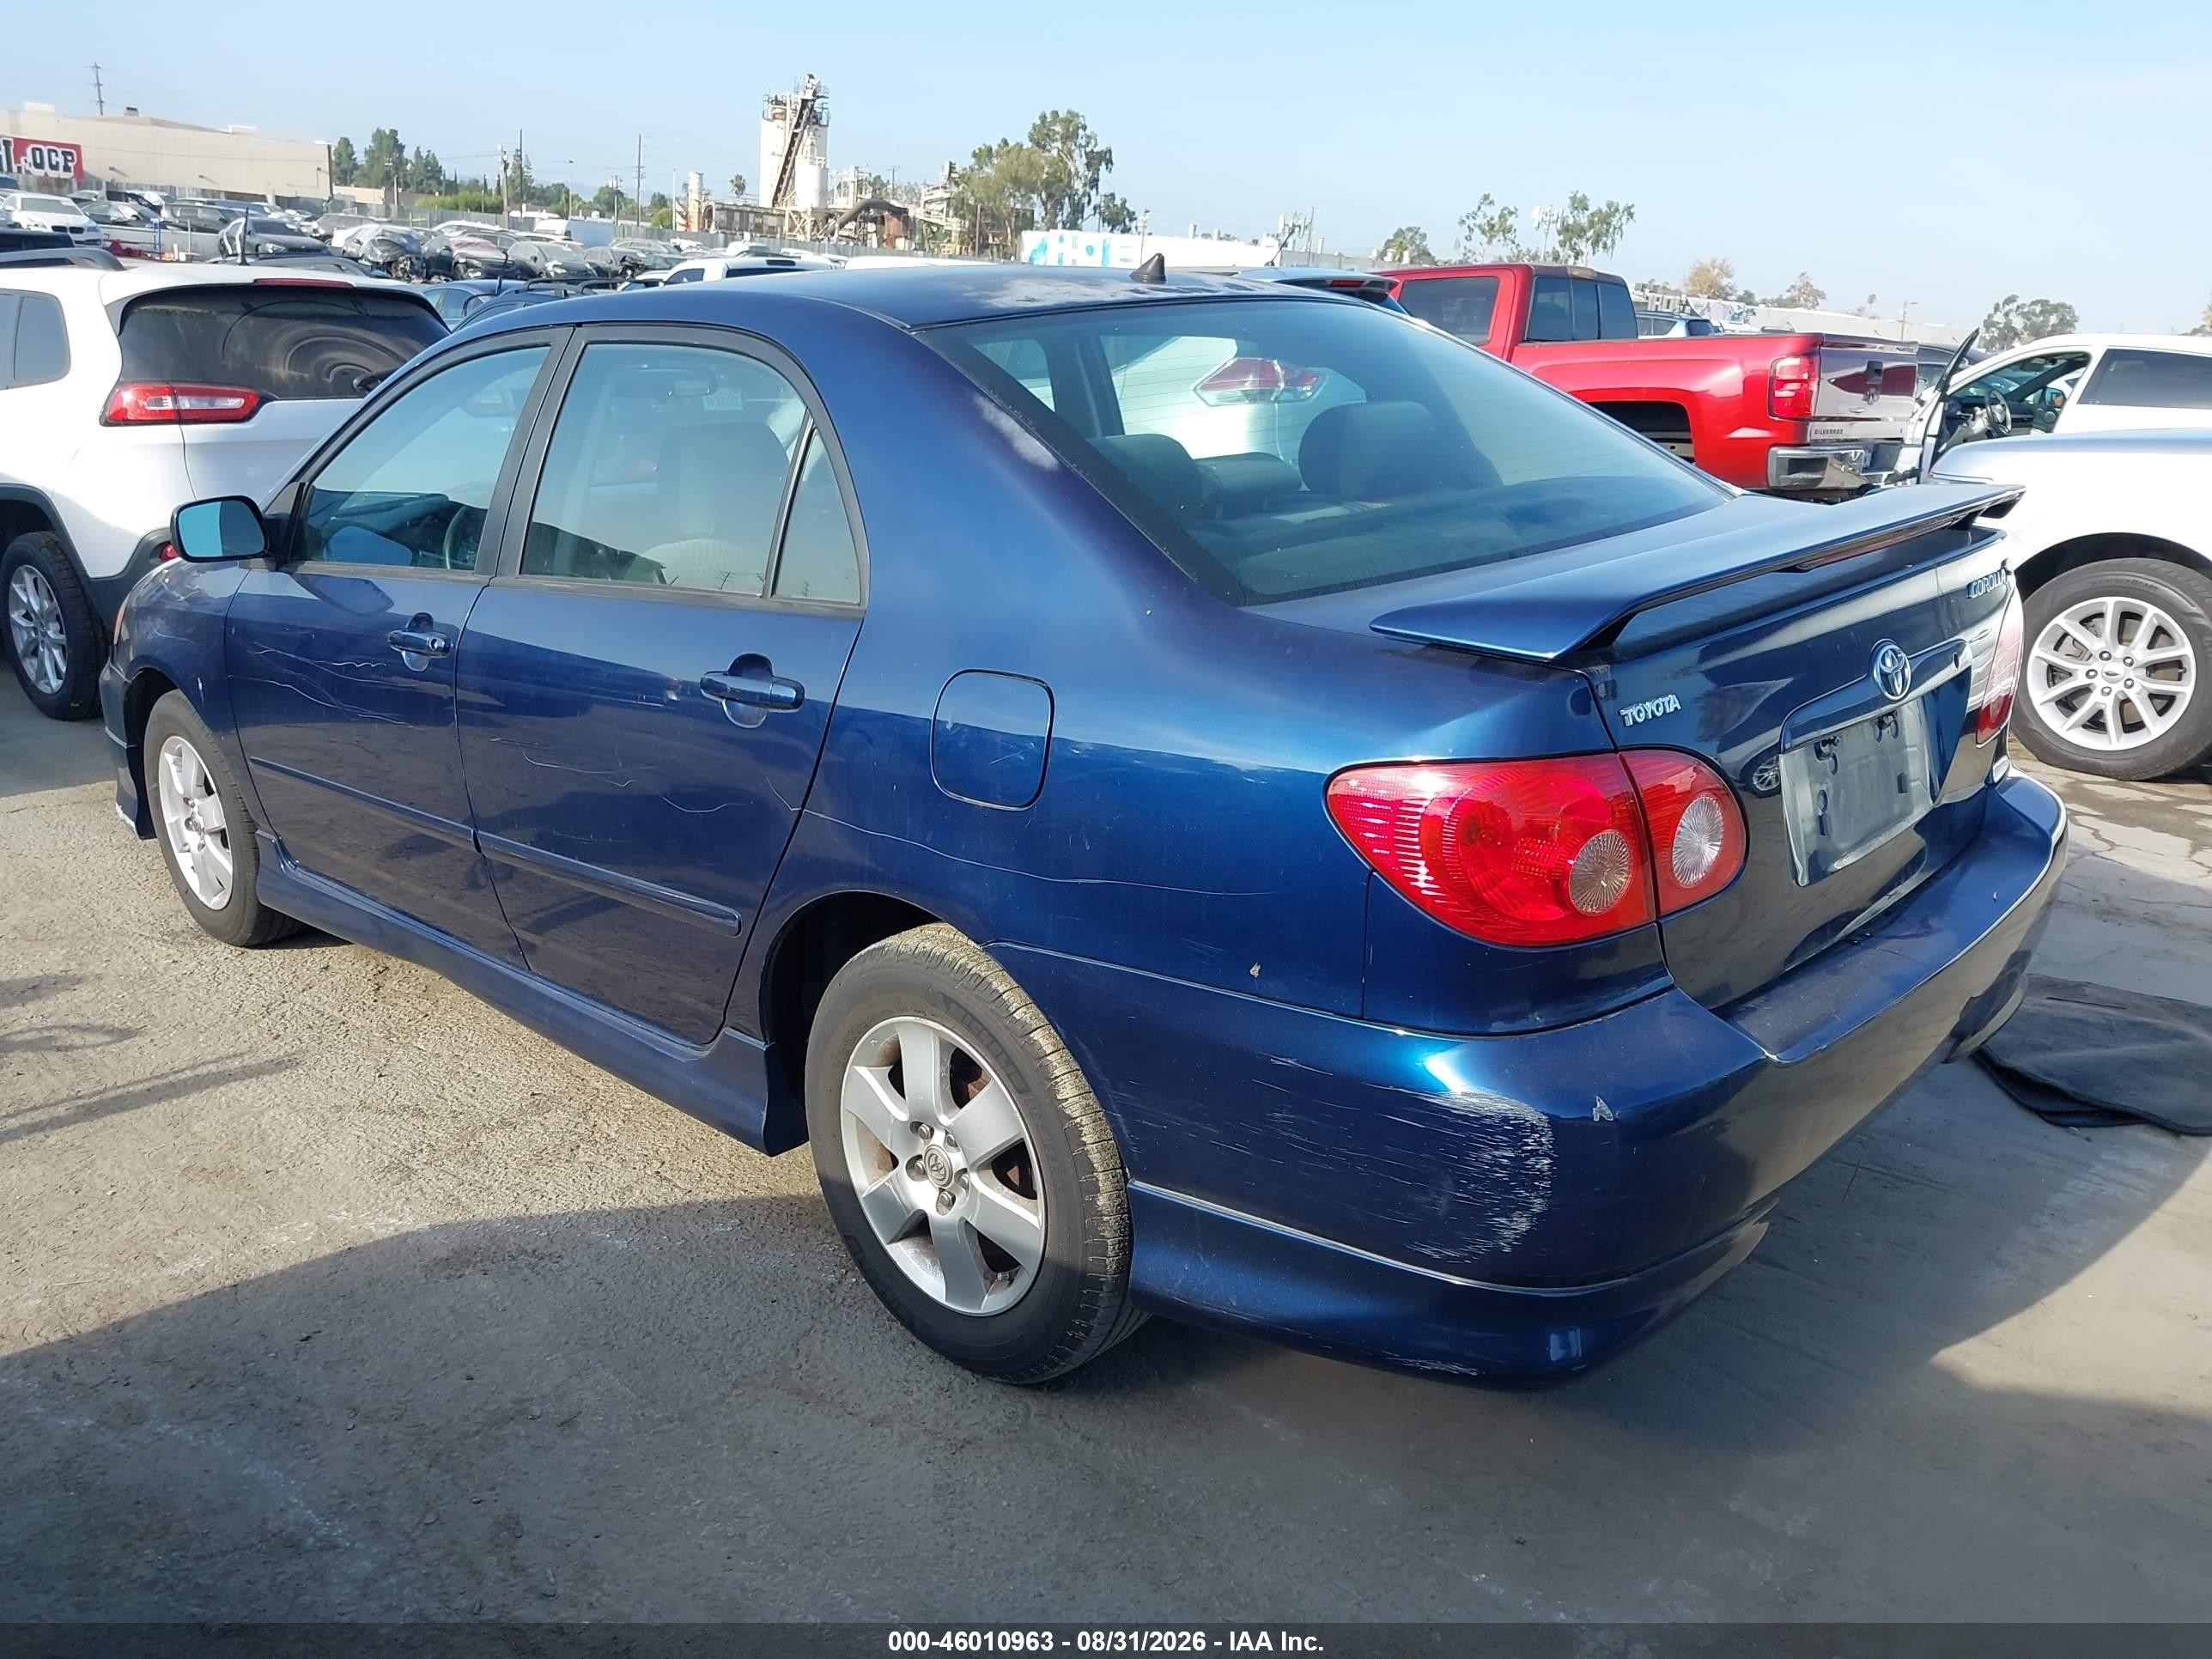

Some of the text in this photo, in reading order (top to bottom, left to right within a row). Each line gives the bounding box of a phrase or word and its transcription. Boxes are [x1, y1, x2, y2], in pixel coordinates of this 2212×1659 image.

[29, 145, 76, 175] OCP
[1966, 568, 2007, 599] COROLLA
[1620, 694, 1682, 727] TOYOTA
